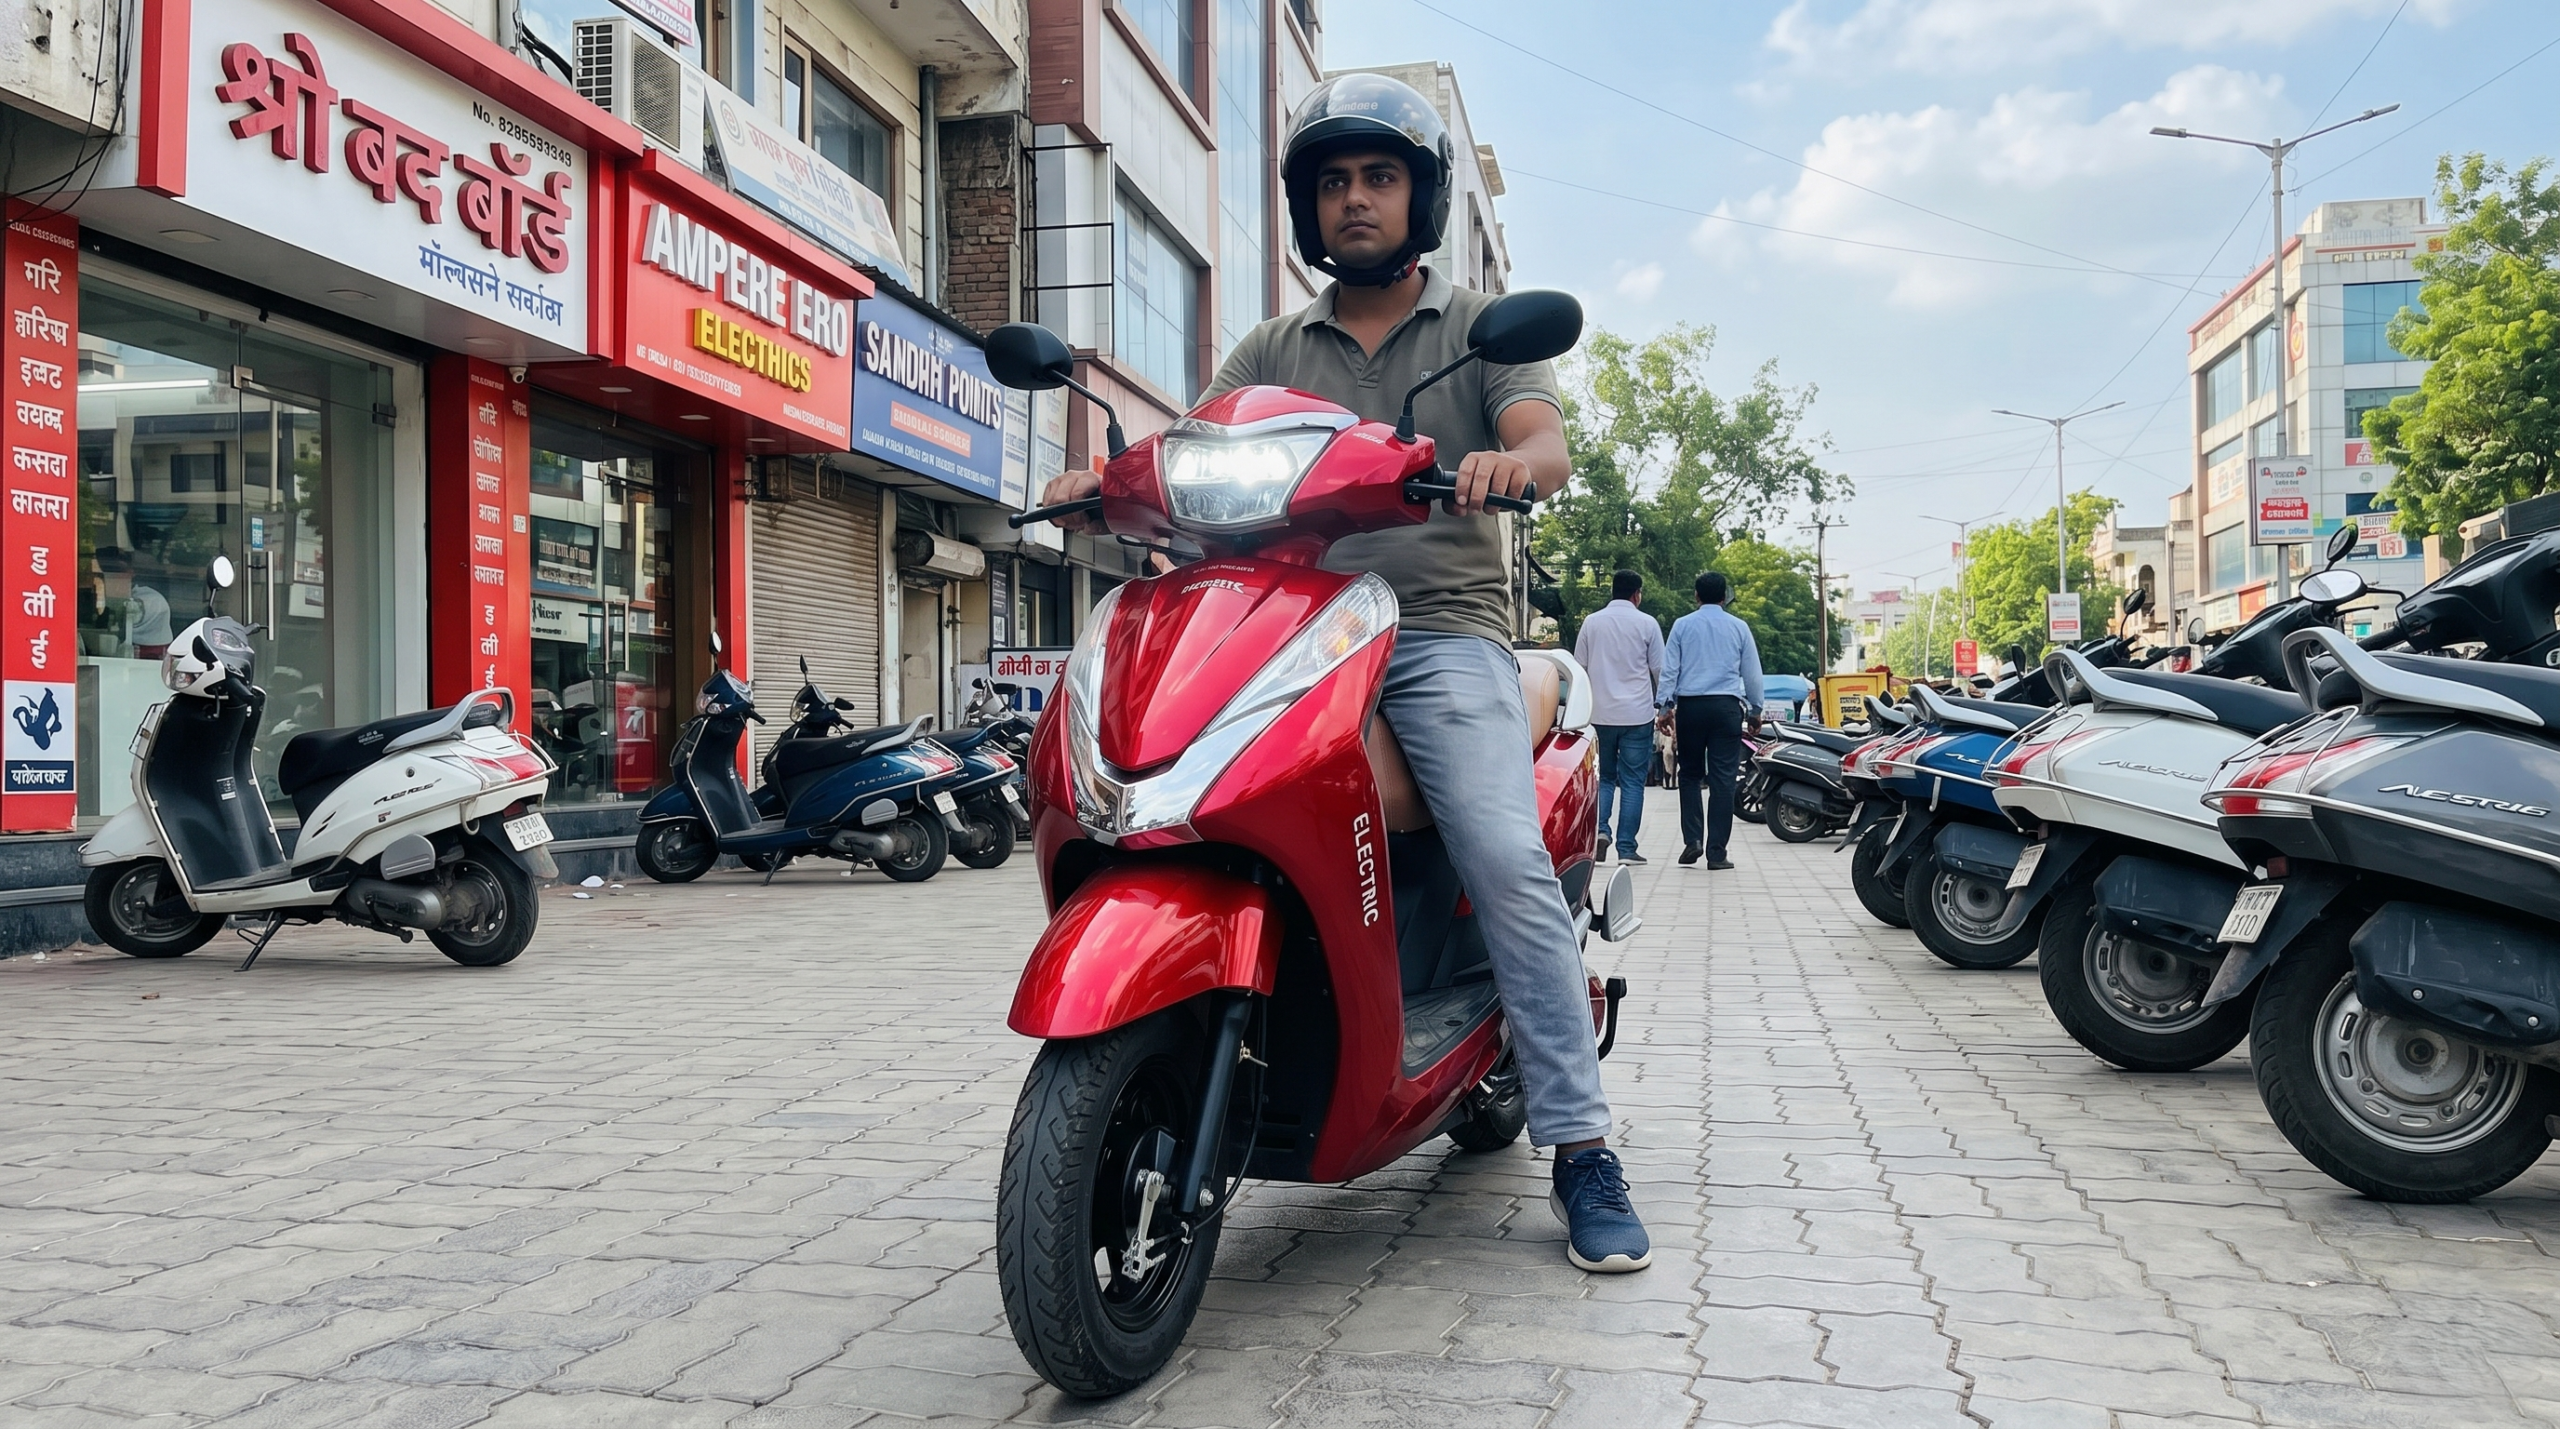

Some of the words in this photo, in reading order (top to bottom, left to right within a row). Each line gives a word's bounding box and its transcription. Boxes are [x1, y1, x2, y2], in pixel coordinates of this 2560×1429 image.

[473, 101, 494, 128] No.
[643, 203, 787, 328] AMPERE
[790, 280, 848, 357] ERO
[694, 308, 811, 393] ELECTHICS
[1353, 812, 1379, 927] ELECTRIC
